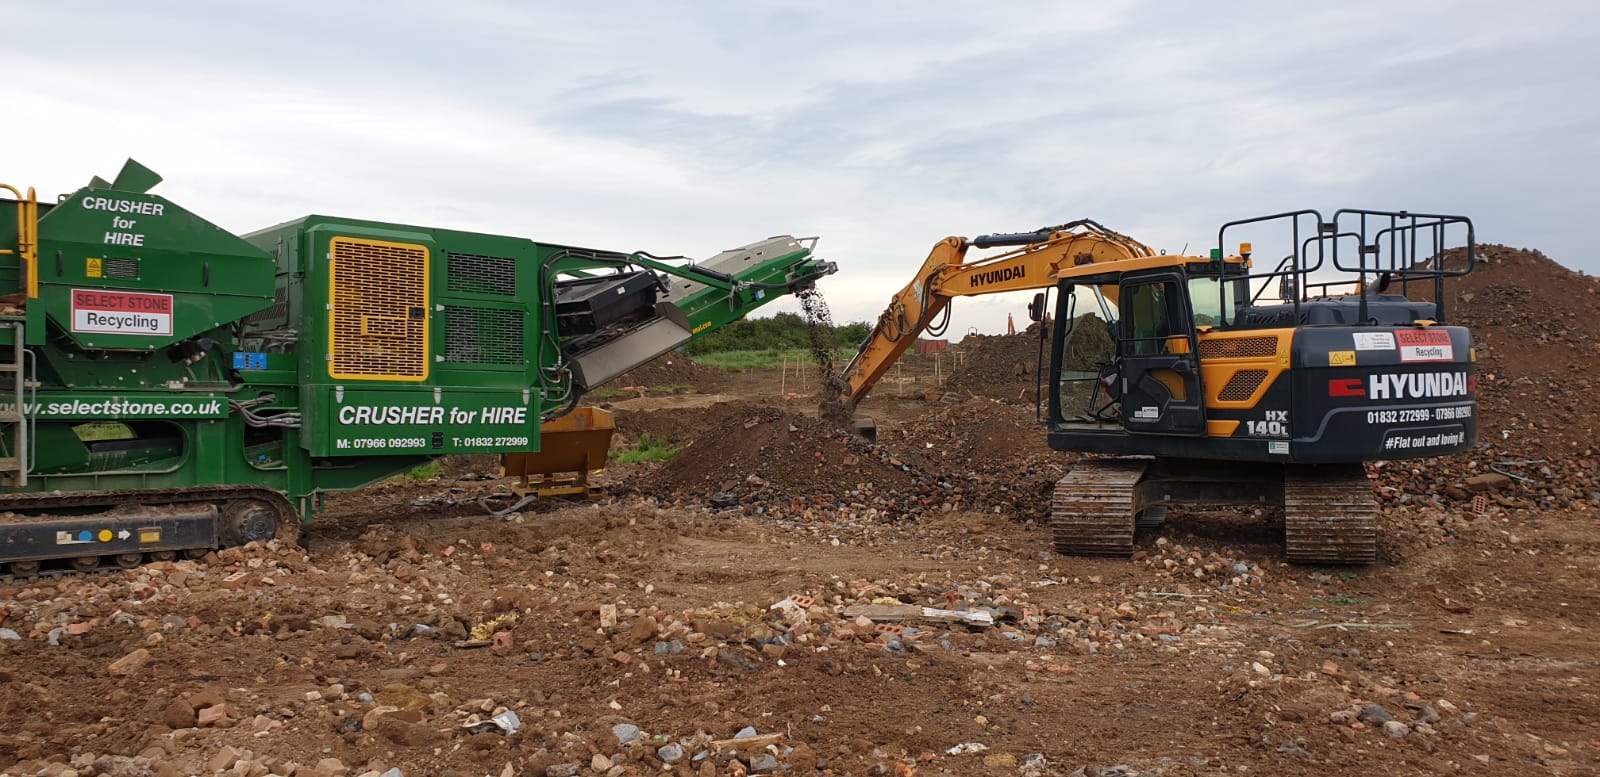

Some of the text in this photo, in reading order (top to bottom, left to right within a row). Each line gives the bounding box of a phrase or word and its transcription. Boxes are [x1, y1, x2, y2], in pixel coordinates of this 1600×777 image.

[82, 196, 164, 216] CRUSHER
[112, 216, 137, 229] for
[103, 231, 145, 247] HIRE
[970, 265, 1026, 287] HYUNDAI
[76, 294, 168, 310] SELECT STONE
[87, 312, 159, 331] Recycling
[1400, 333, 1427, 343] SELECT
[1415, 347, 1443, 358] Recycling
[1369, 371, 1468, 400] HYUNDAI
[338, 405, 528, 425] CRUSHER for HIRE
[1265, 410, 1289, 421] HX
[1367, 410, 1398, 424] 01832
[1399, 409, 1430, 423] 272999
[1435, 407, 1455, 420] 07966
[336, 438, 426, 449] M: 07966 092993
[452, 436, 529, 447] T: 01832 272999
[1385, 436, 1411, 450] #Flat
[1412, 435, 1426, 448] out
[1426, 434, 1441, 447] and
[1441, 432, 1458, 446] loving
